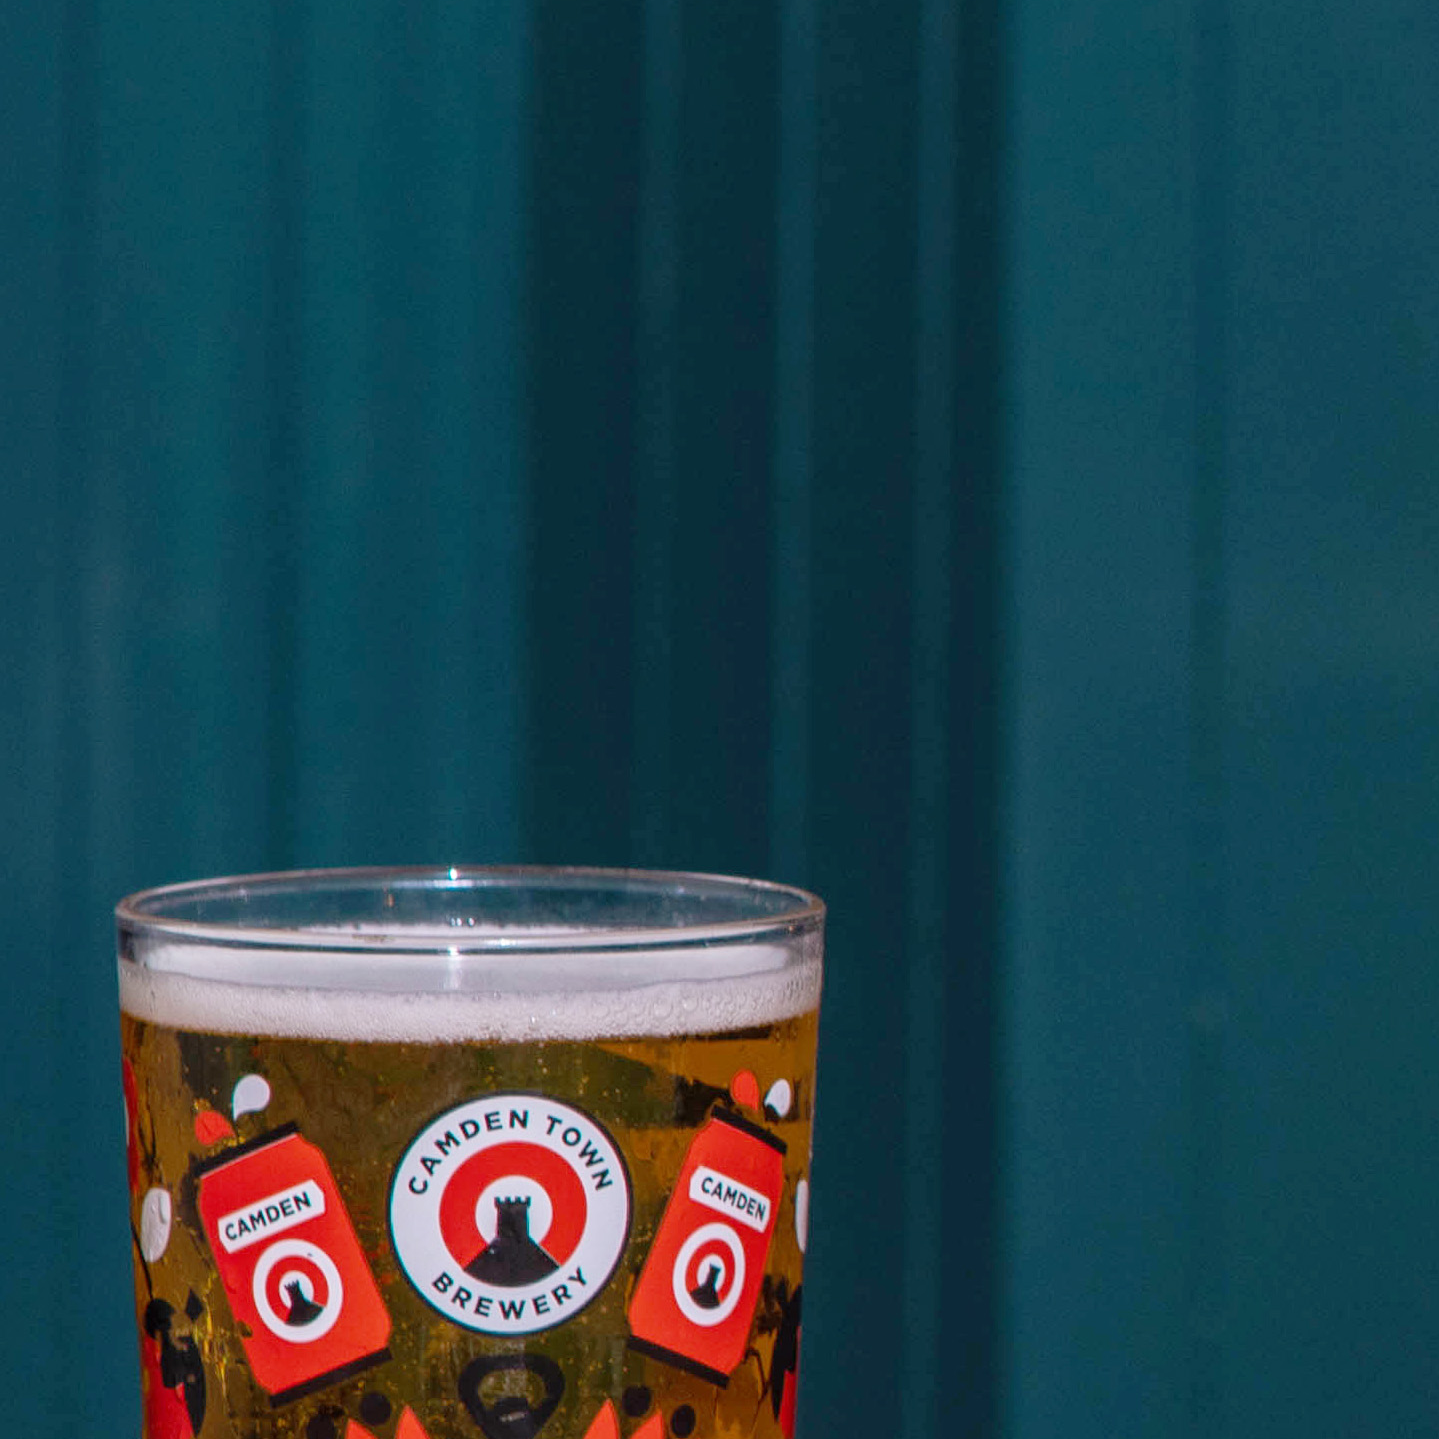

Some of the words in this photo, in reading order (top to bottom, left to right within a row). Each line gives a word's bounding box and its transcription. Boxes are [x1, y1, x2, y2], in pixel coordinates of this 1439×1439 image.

[408, 1109, 529, 1195] CAMDEN
[546, 1114, 614, 1191] TOWN
[225, 1190, 312, 1240] CAMDEN
[701, 1176, 766, 1222] CAMDEN
[432, 1266, 587, 1320] BREWERY
